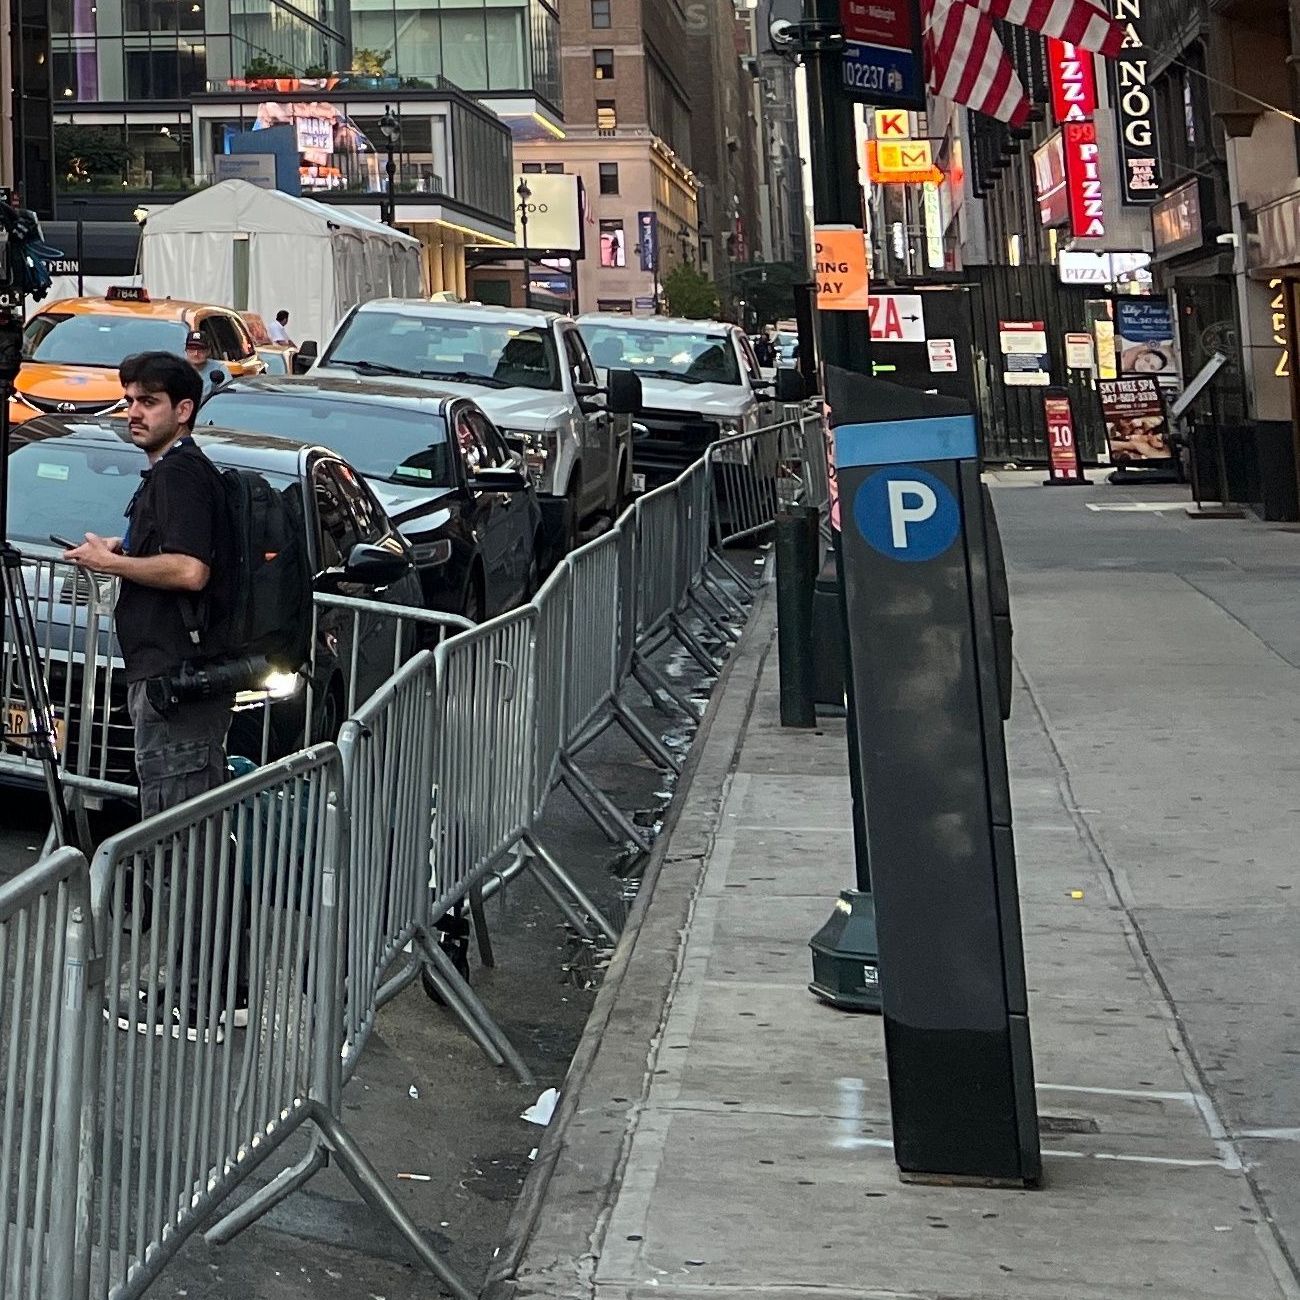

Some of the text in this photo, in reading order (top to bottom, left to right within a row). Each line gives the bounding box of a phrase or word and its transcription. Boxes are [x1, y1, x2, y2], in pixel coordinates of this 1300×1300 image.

[842, 61, 885, 90] 102237
[882, 114, 904, 134] K
[1080, 143, 1105, 236] PIZZA
[1065, 268, 1108, 280] PIZZA
[1099, 379, 1156, 395] SKY TREE SPA
[1049, 426, 1072, 447] 10
[887, 480, 938, 549] P
